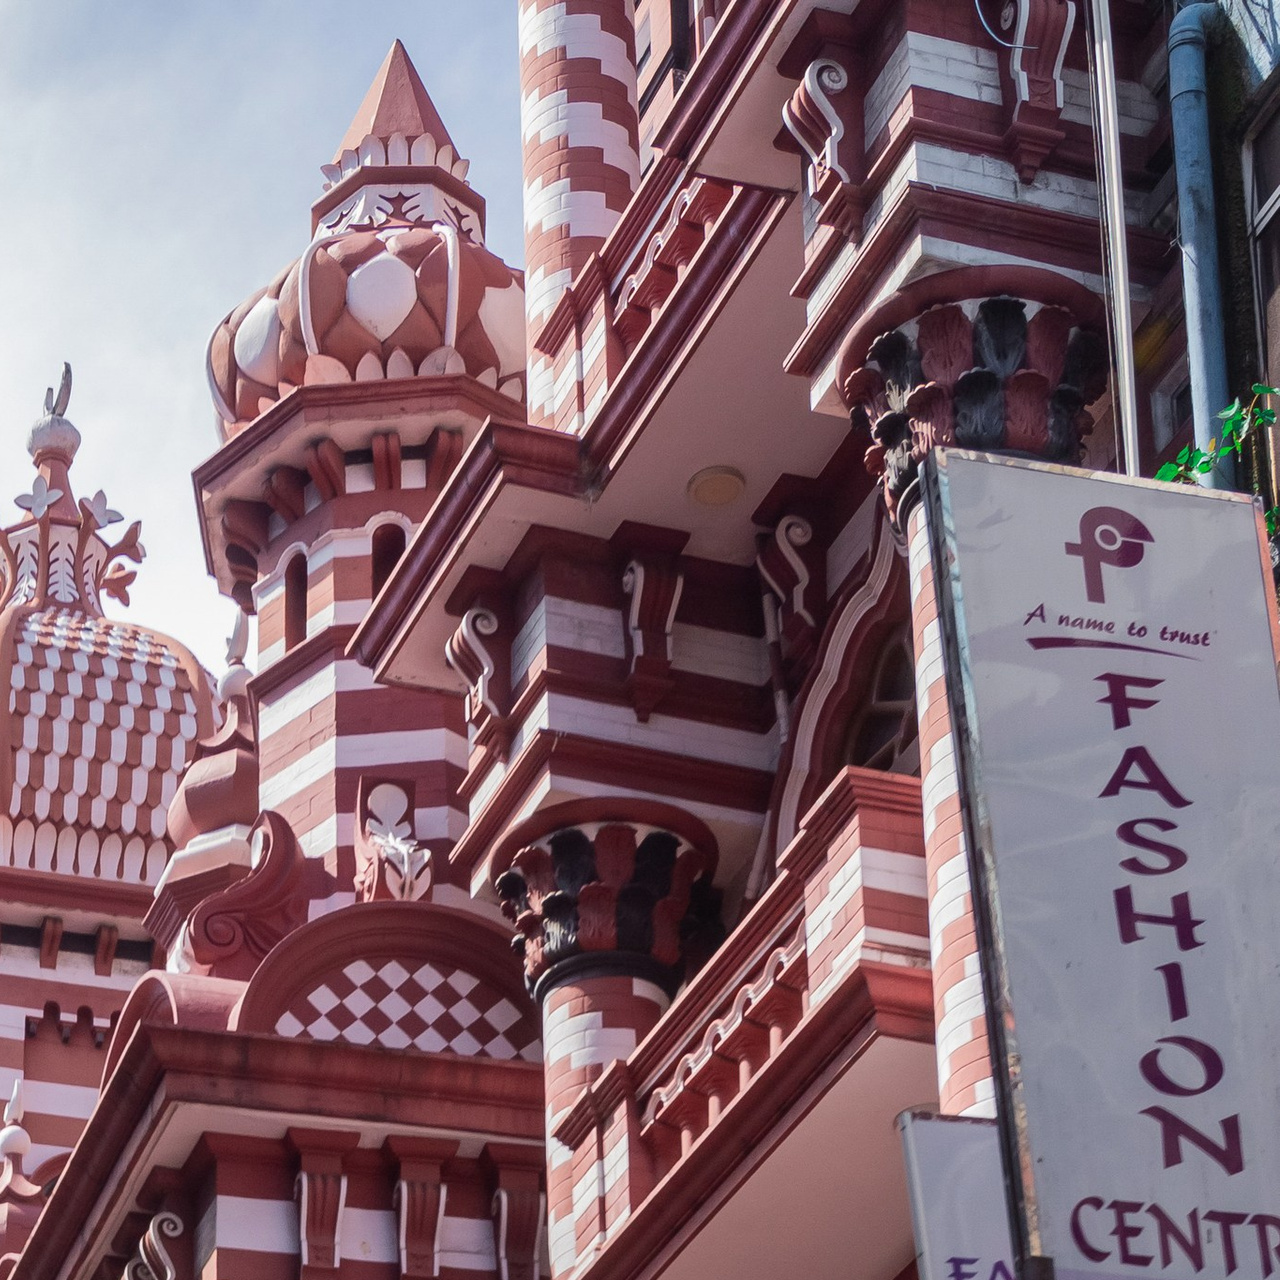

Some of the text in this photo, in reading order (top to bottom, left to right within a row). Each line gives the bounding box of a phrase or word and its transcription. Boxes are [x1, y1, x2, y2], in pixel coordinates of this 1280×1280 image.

[1024, 603, 1212, 647] A name to trust
[1093, 672, 1245, 1176] FASHION
